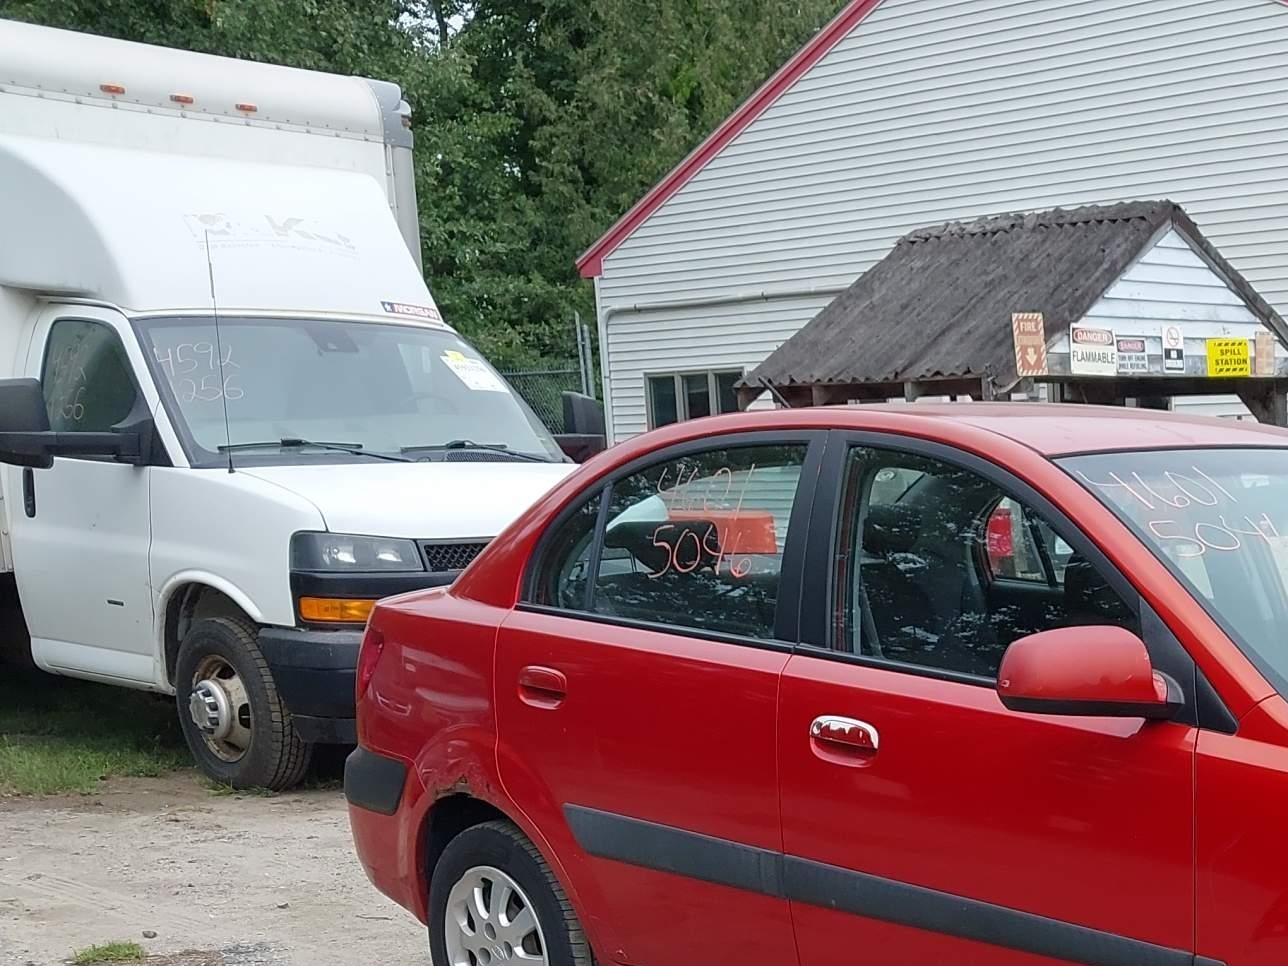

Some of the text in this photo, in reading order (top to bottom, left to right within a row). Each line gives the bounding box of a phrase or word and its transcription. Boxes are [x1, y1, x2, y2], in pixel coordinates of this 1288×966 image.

[1020, 320, 1037, 333] FIRE
[1077, 330, 1109, 342] DANGER
[1072, 350, 1115, 365] FLAMMABLE
[1219, 348, 1242, 356] SPILL
[1214, 358, 1248, 366] STATION
[1076, 465, 1239, 510] 4601
[647, 522, 752, 578] 5046
